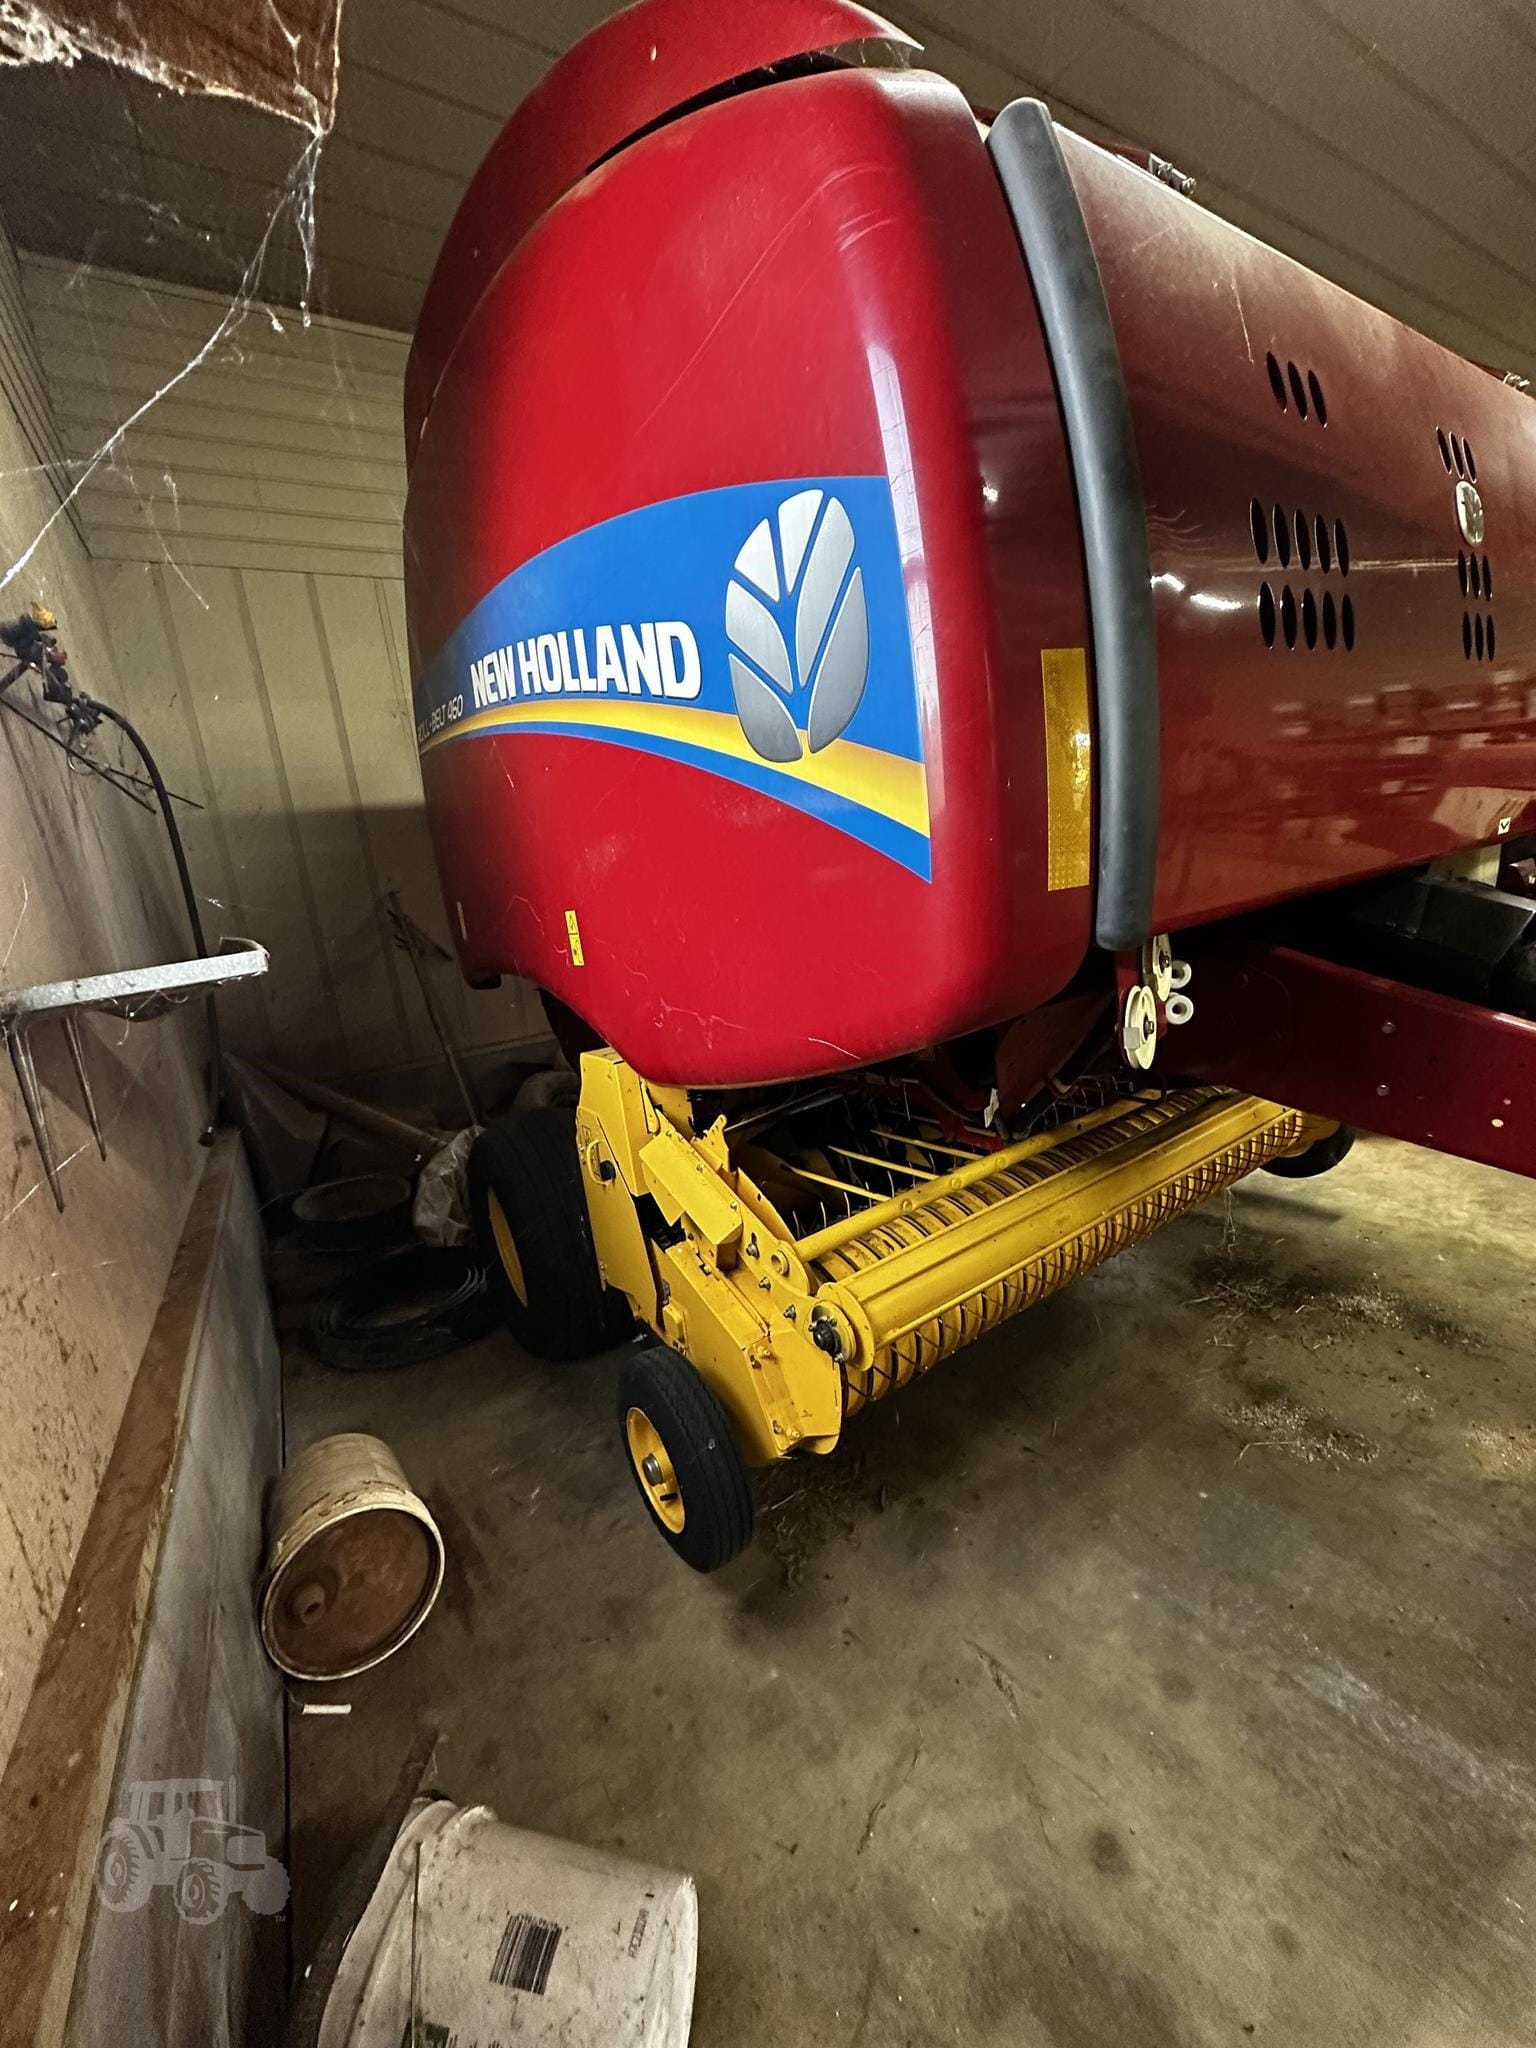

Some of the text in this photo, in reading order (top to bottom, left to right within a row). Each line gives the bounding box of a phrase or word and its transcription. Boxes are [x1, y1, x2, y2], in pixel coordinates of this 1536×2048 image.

[470, 620, 702, 709] NEW HOLLAND
[447, 694, 463, 720] 460
